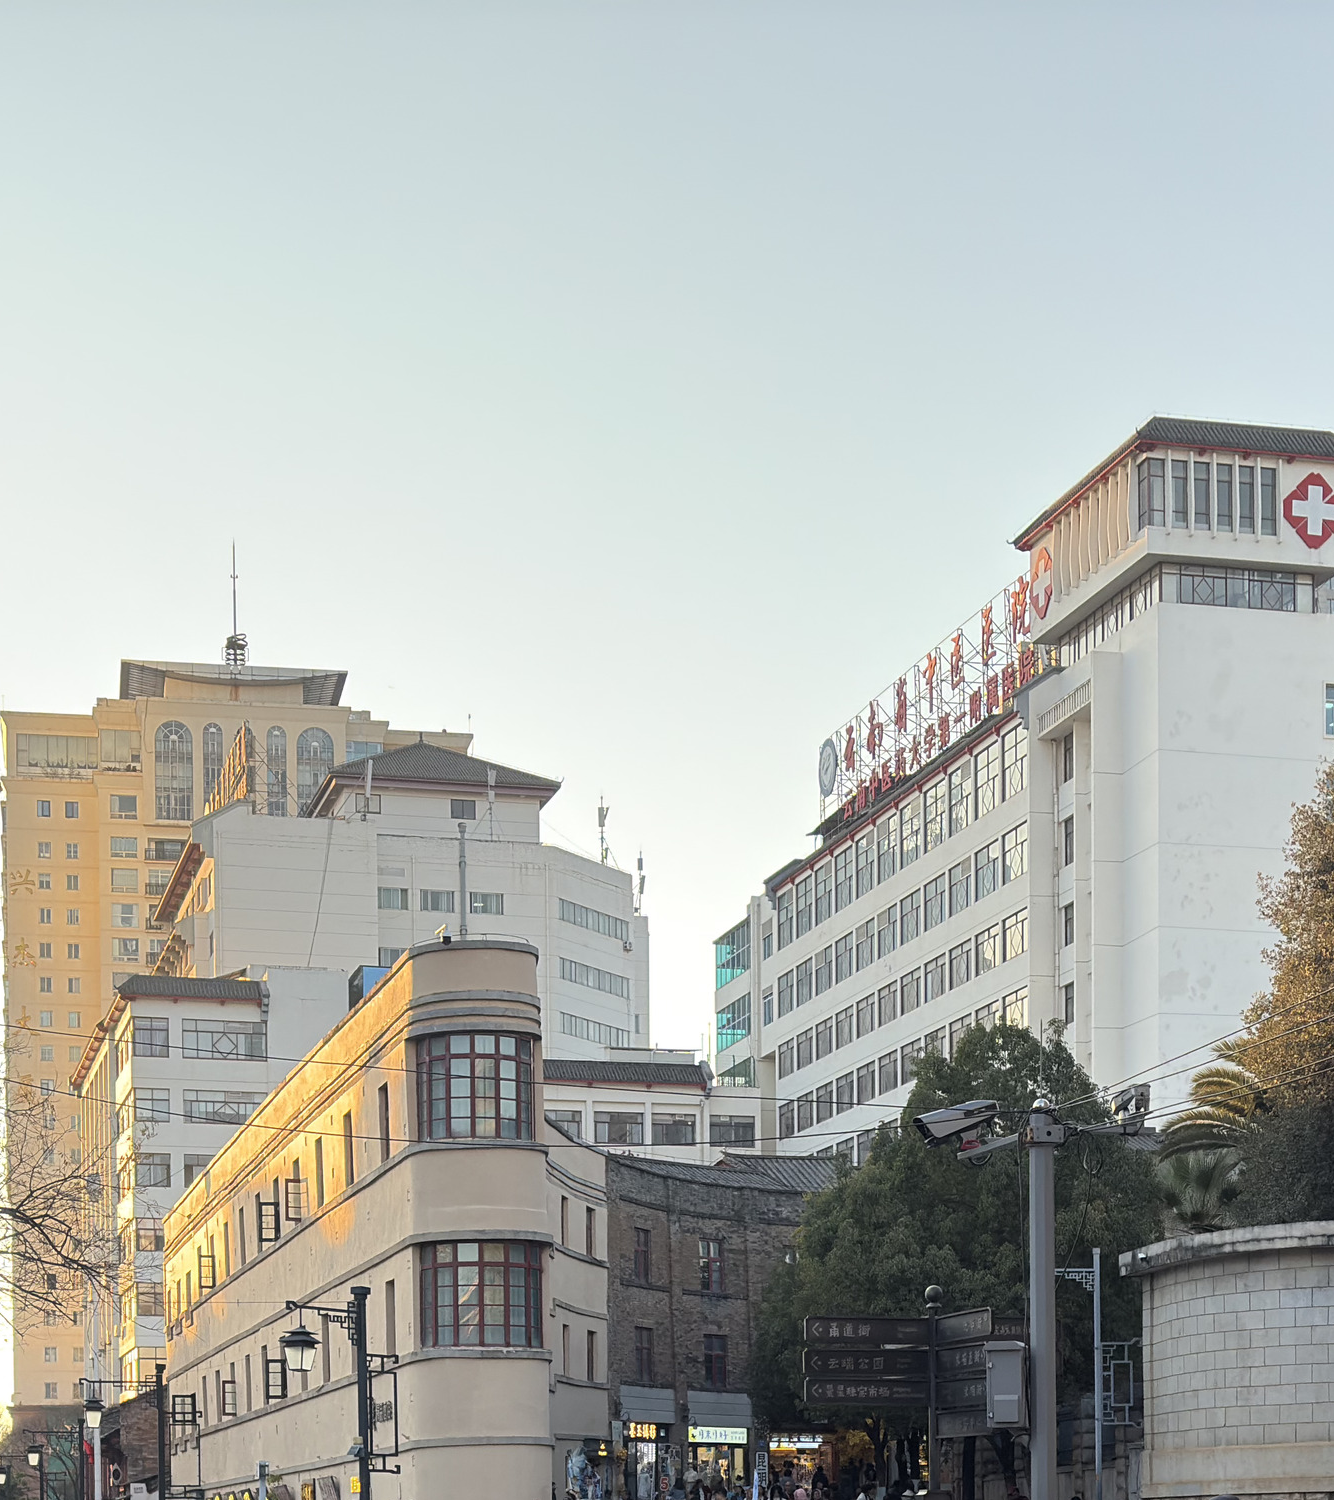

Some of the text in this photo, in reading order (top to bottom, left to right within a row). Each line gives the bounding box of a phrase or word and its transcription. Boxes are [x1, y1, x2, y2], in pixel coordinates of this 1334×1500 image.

[844, 576, 1030, 773] 云南省中医医院
[829, 1322, 871, 1337] 甬道街
[828, 1357, 884, 1370] 云端公园
[757, 1453, 767, 1486] 昆明
